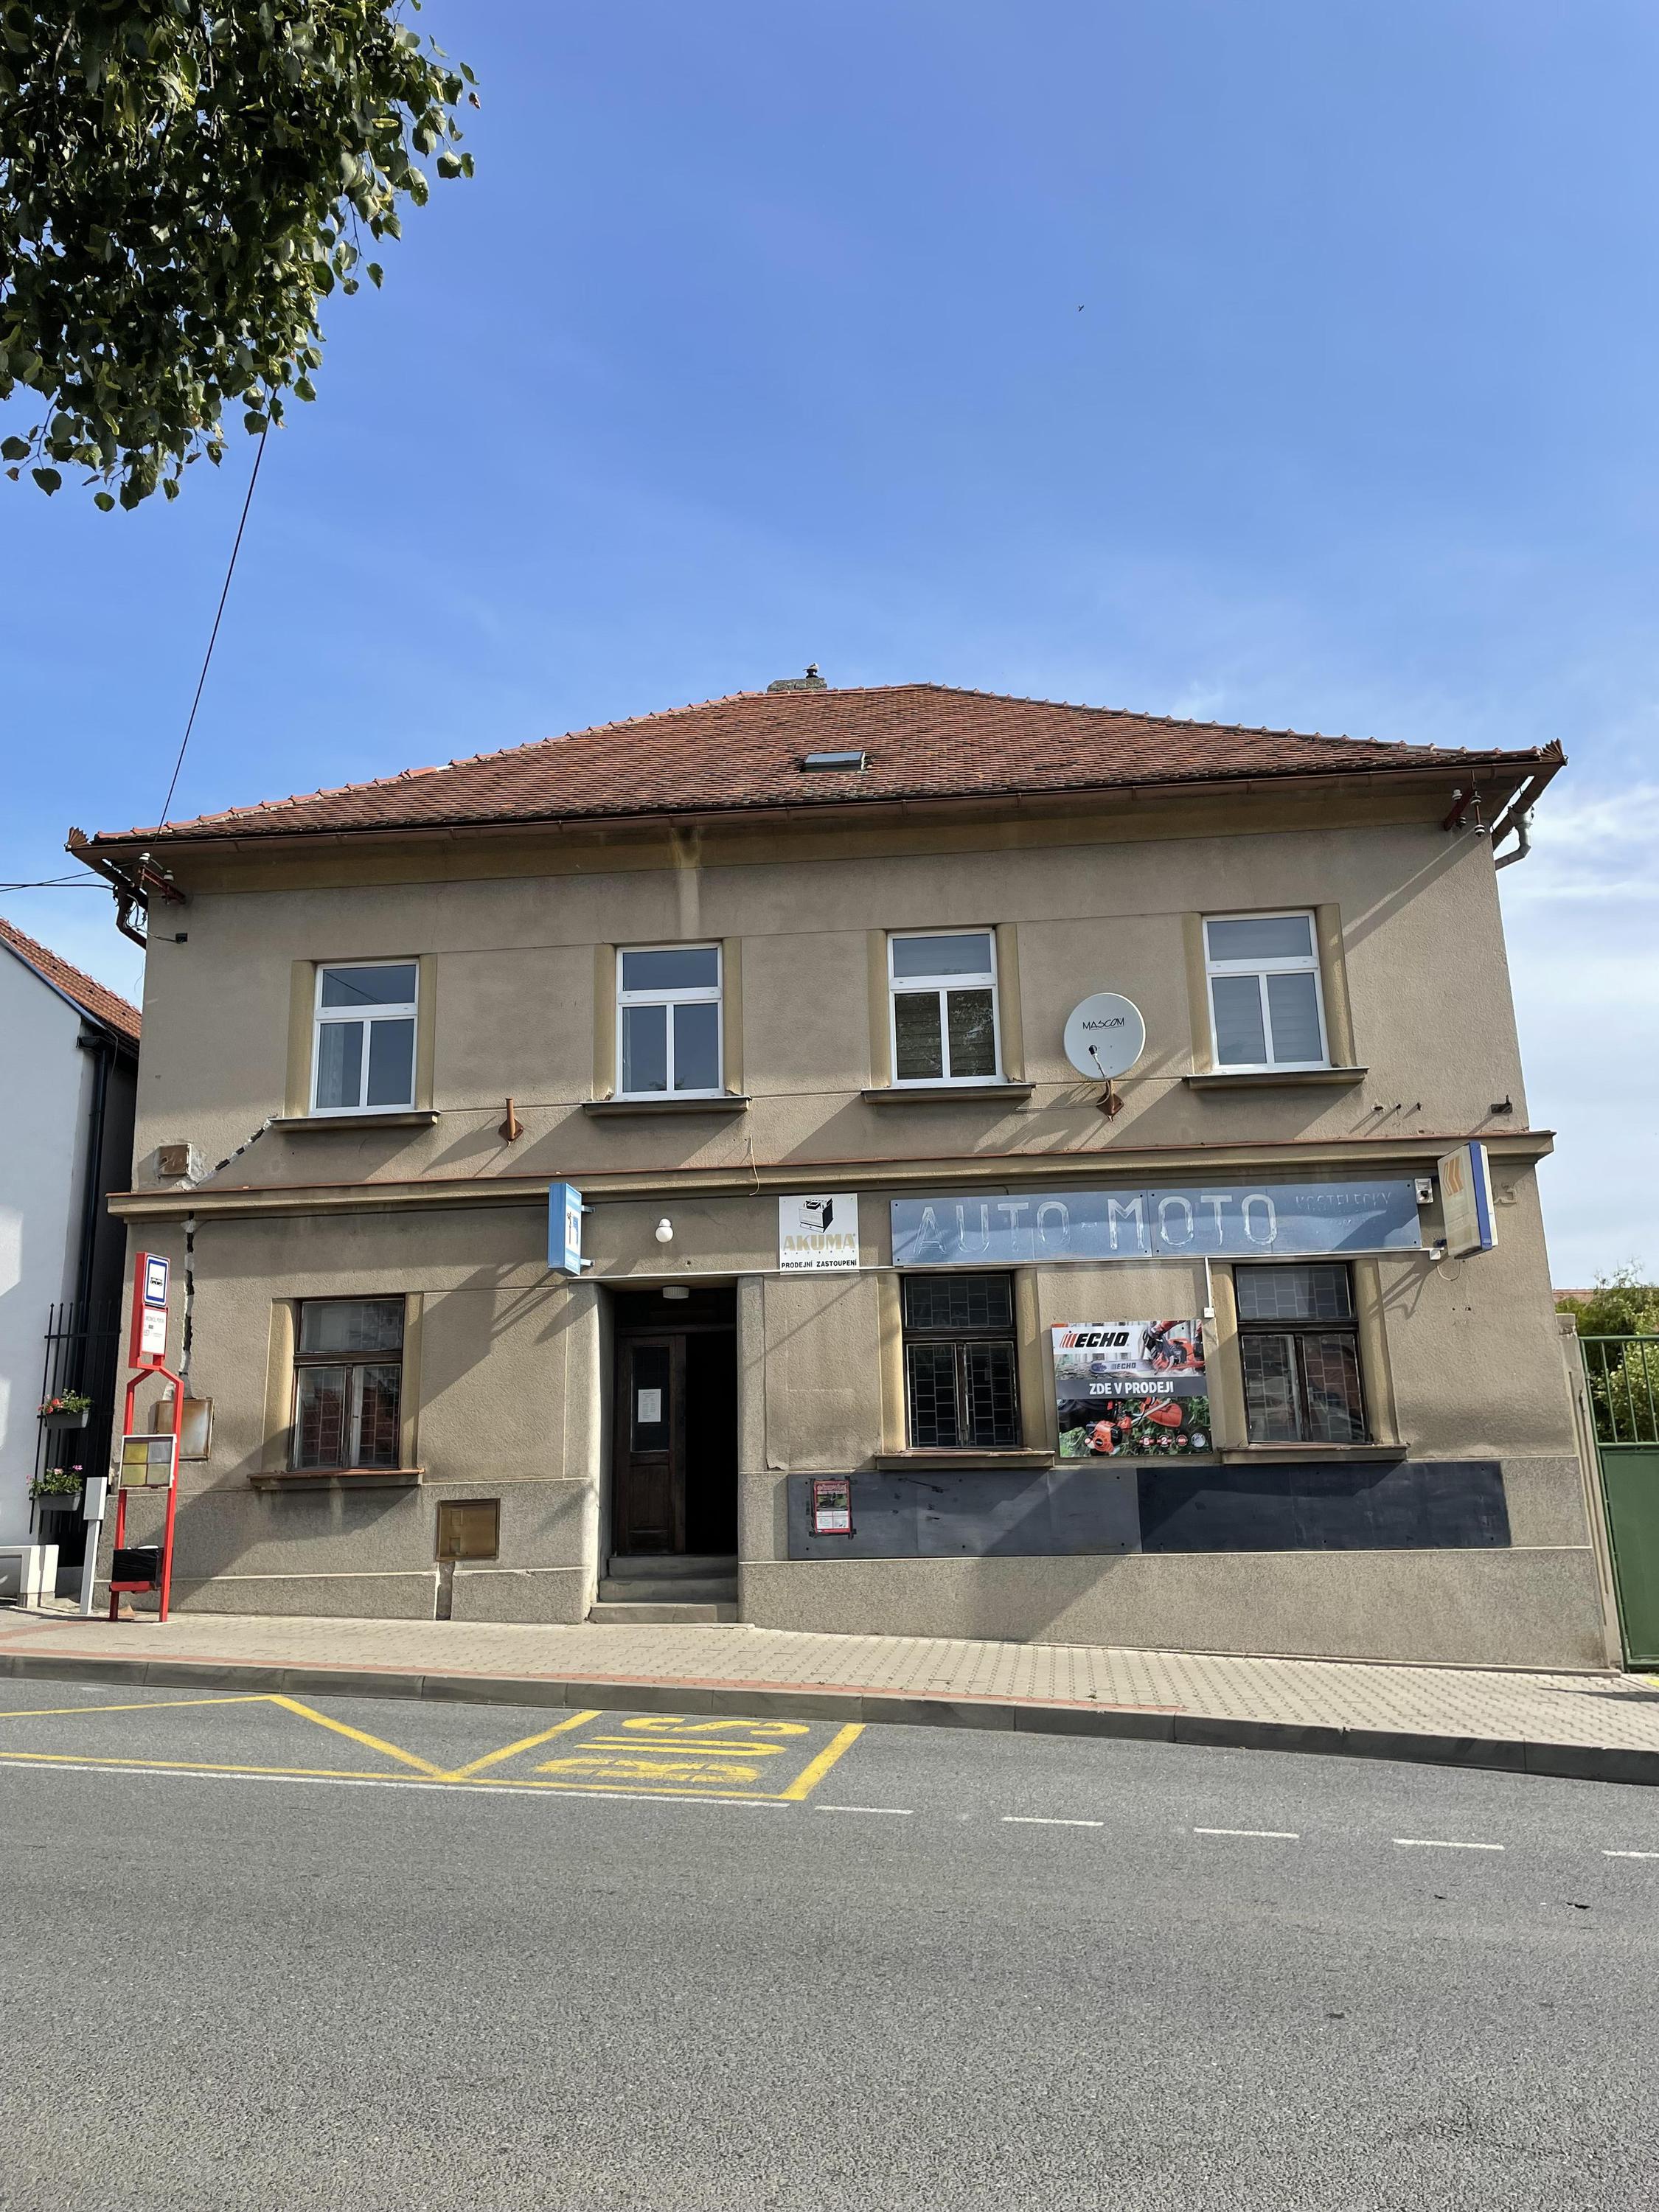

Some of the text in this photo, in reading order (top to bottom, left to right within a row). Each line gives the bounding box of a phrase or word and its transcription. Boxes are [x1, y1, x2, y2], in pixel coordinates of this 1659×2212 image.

[1082, 1018, 1125, 1030] MASCOM
[783, 1233, 855, 1251] AKUMA
[782, 1259, 857, 1268] PRODEJNÍ ZASTOUPENÍ
[1074, 1332, 1130, 1348] ECHO
[1089, 1381, 1174, 1395] ZDE V PRODEJI
